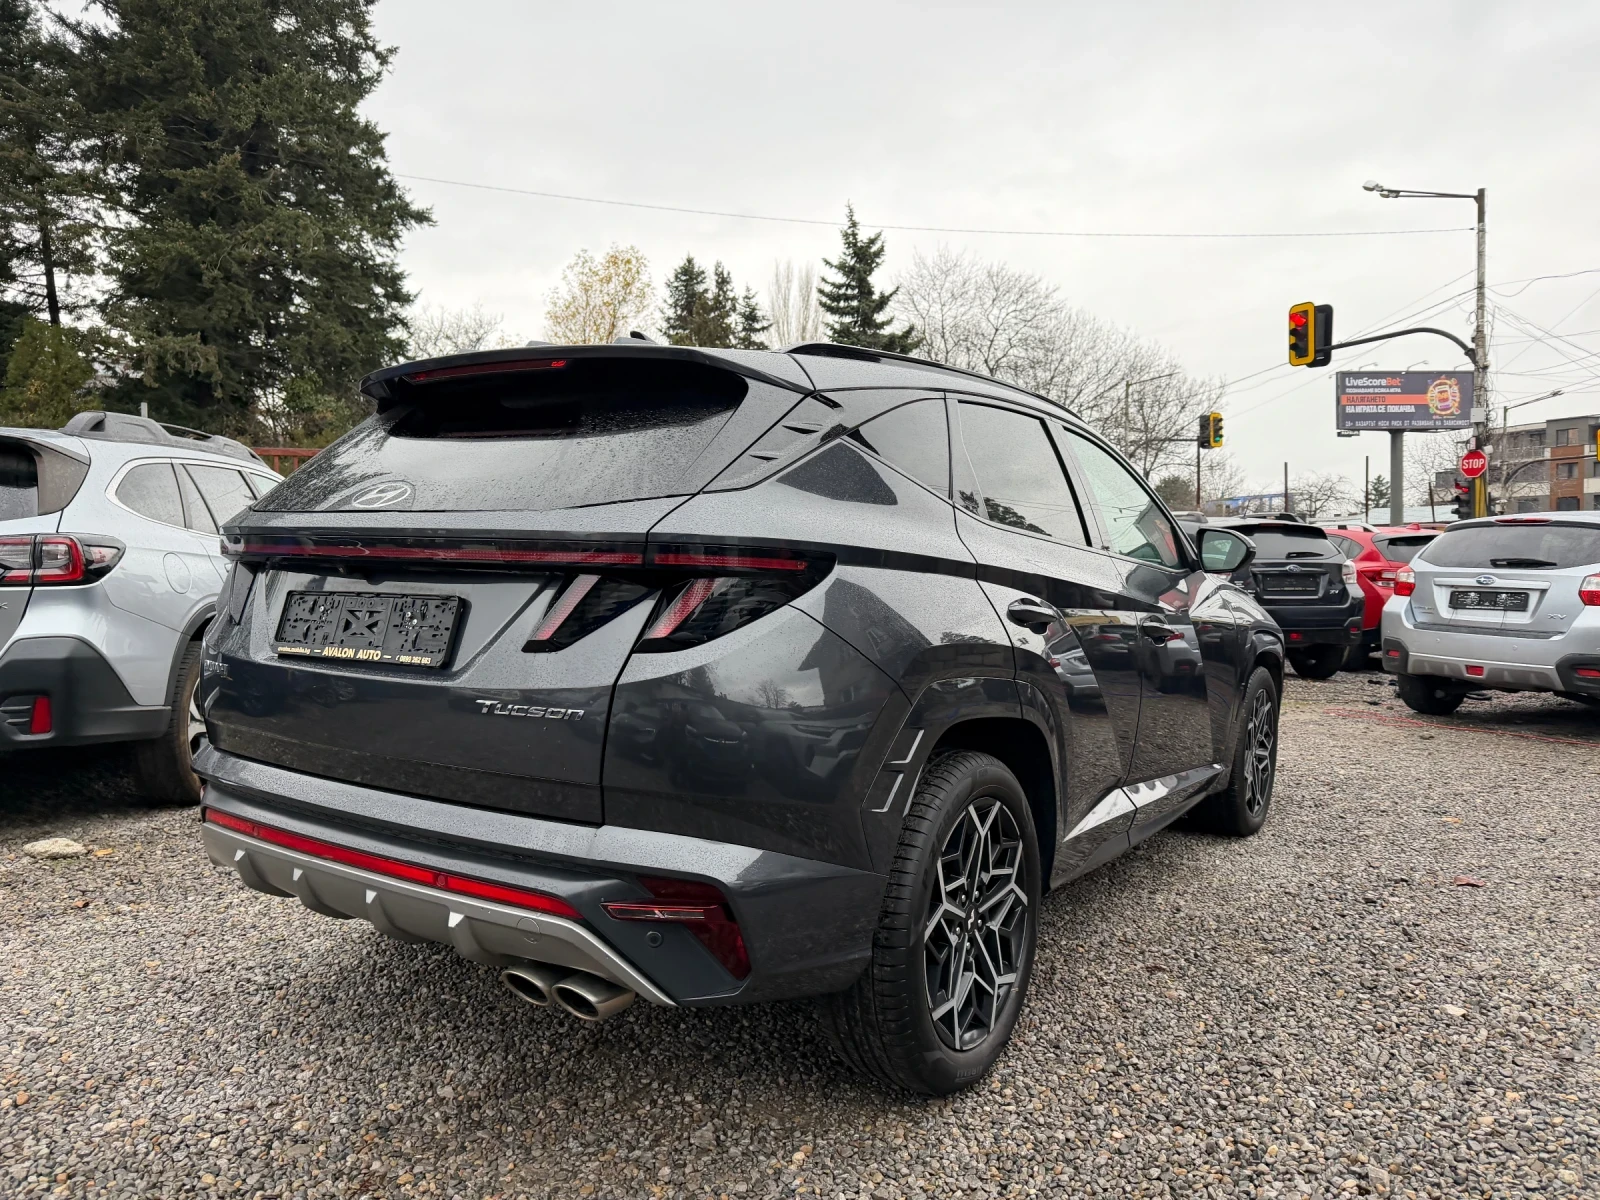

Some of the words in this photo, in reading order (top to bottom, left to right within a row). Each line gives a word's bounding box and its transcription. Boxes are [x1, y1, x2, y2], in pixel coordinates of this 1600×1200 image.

[1345, 377, 1402, 386] LiveScoreBet
[1462, 458, 1485, 470] STOP
[322, 646, 354, 659] AVALON
[356, 648, 382, 661] AUTO
